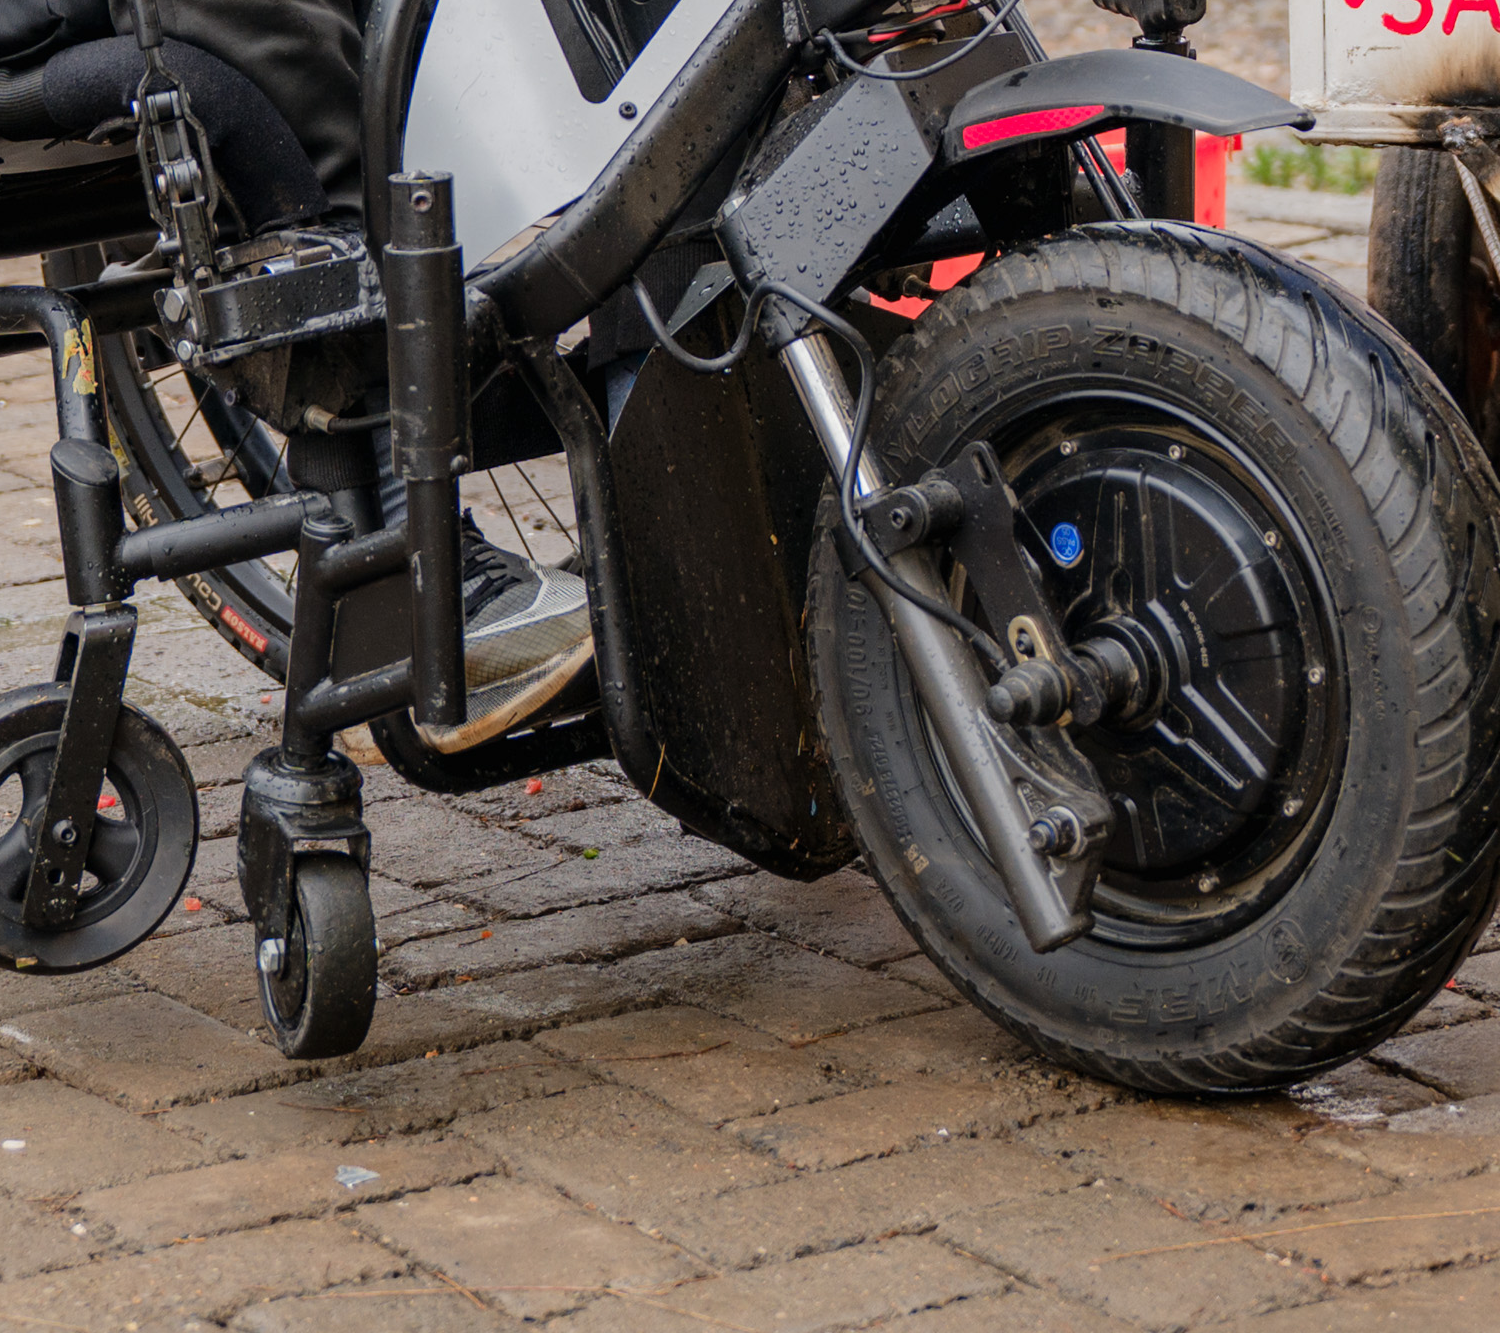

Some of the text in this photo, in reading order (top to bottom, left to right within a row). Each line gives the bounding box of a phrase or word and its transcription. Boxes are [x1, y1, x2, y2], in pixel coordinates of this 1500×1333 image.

[1091, 325, 1300, 464] ZAPPER
[221, 607, 267, 652] RALSON
[1108, 961, 1256, 1023] MRF
